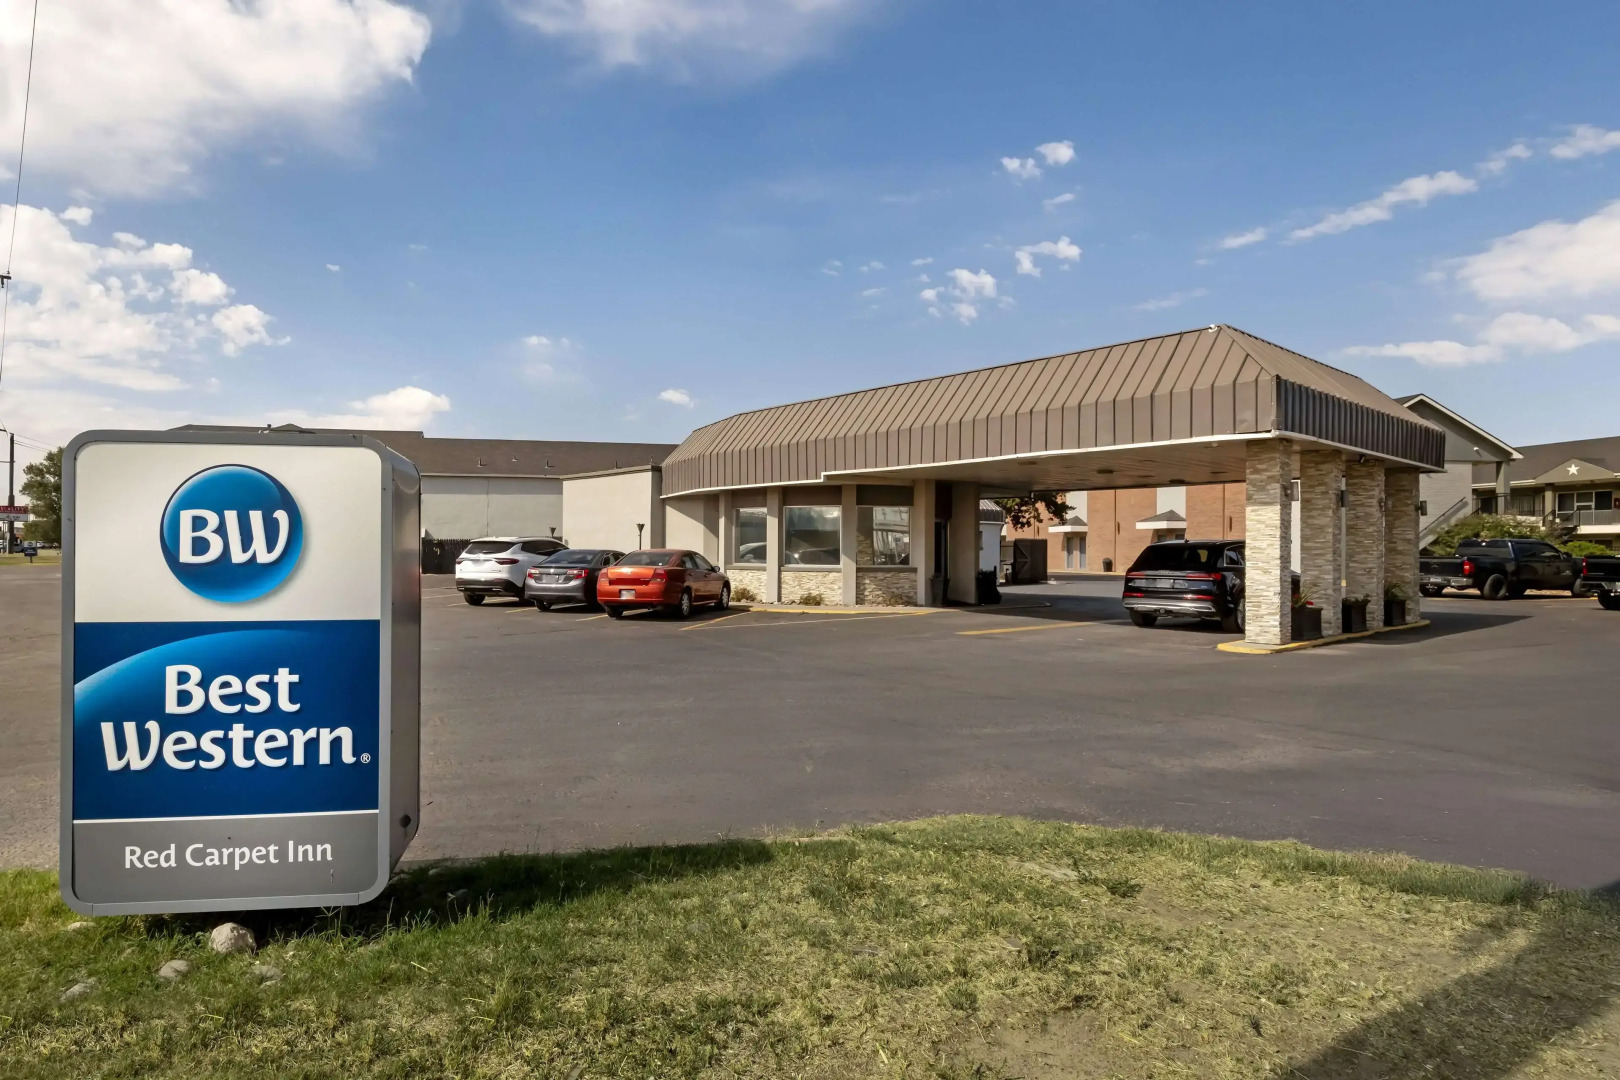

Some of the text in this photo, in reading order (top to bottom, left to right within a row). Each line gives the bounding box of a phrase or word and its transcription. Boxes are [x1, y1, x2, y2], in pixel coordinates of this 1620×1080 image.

[178, 509, 290, 565] BW
[165, 664, 301, 714] Best
[100, 721, 357, 771] Western
[124, 840, 333, 871] Red Carpet Inn
